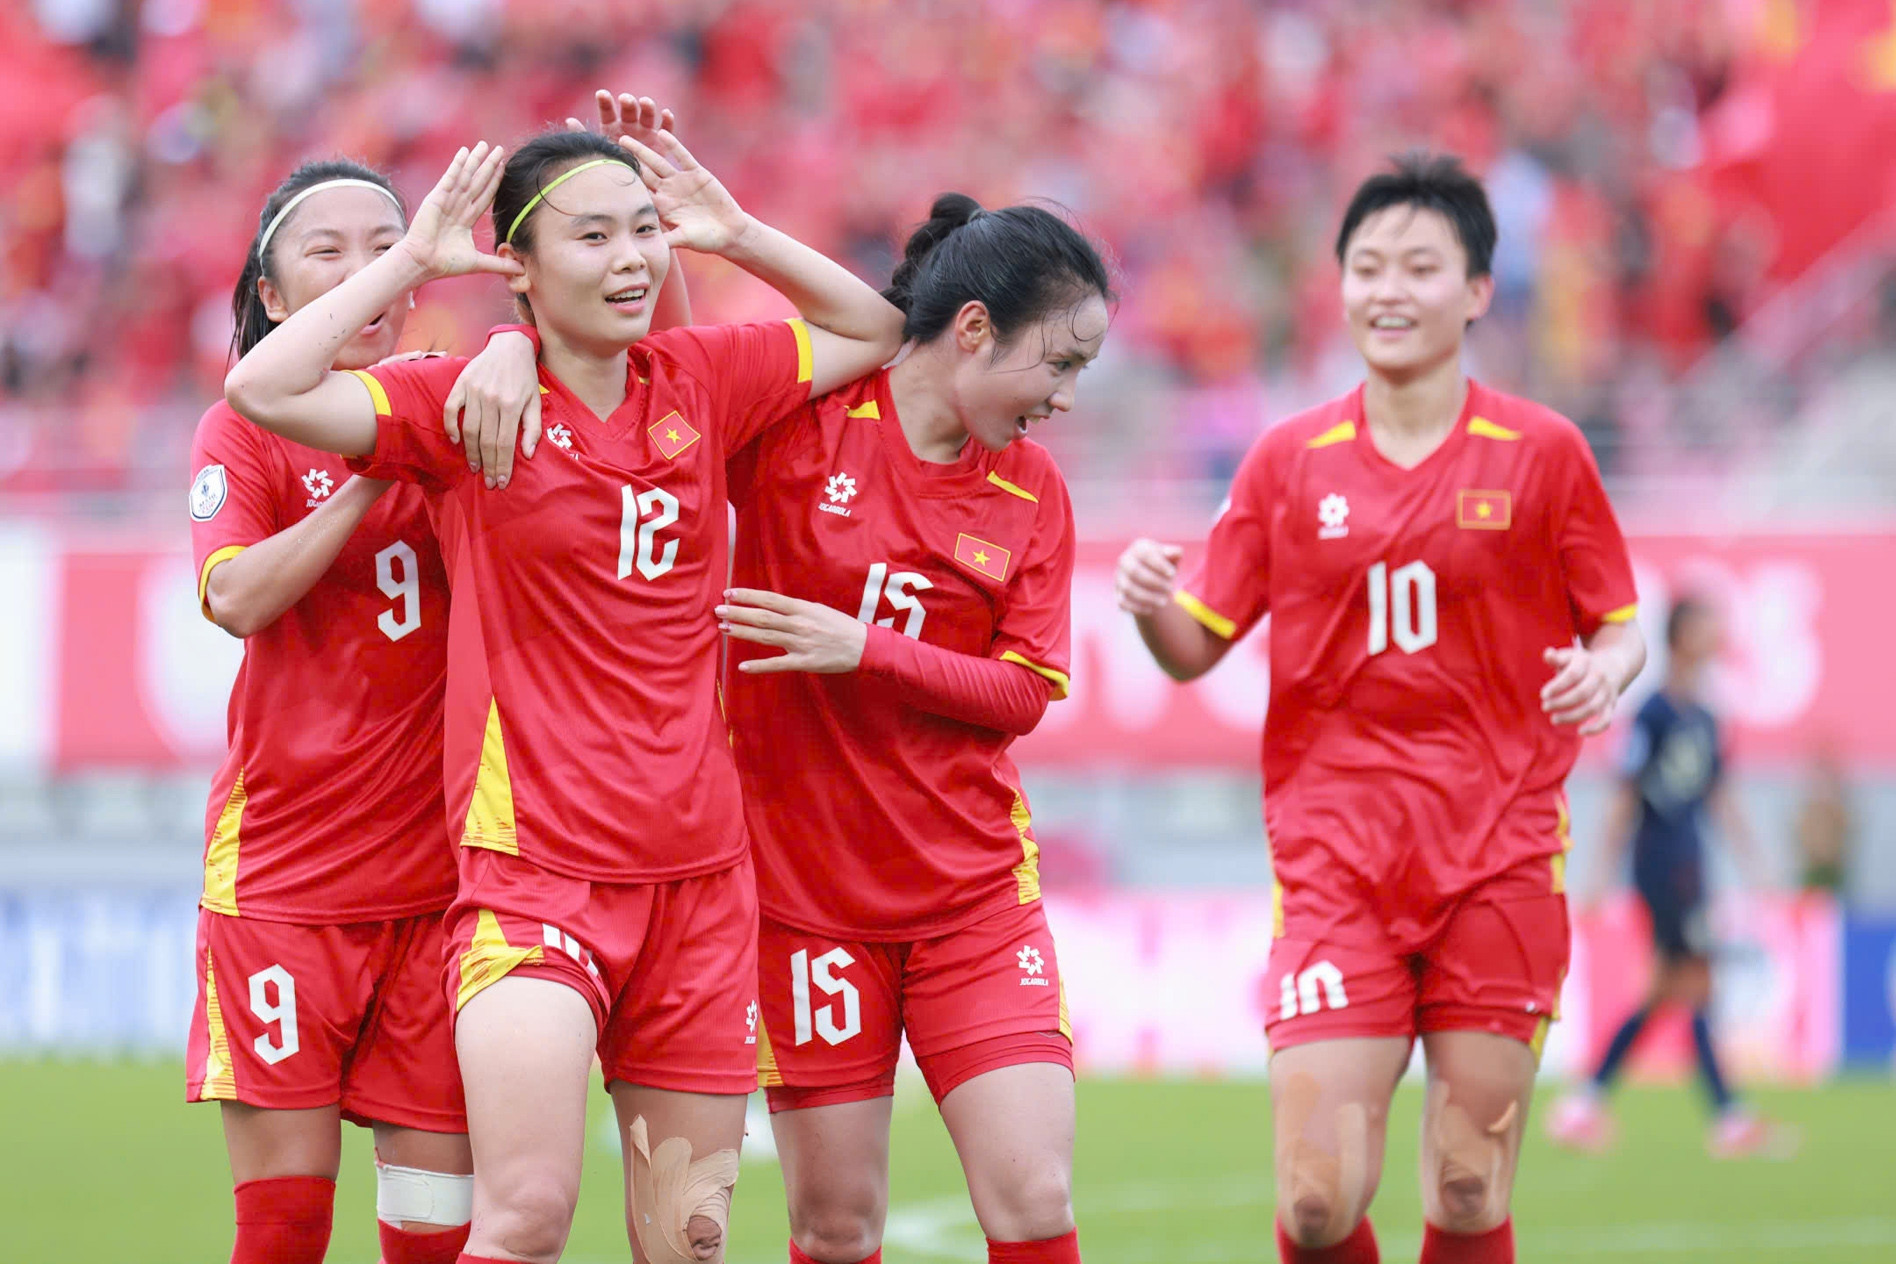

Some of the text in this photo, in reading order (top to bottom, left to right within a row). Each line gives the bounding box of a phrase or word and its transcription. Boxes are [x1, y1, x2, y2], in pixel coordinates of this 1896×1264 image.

[617, 484, 680, 581] 12
[375, 539, 421, 642] 9
[857, 562, 934, 641] 15
[1367, 560, 1438, 656] 10
[248, 964, 299, 1065] 9
[790, 946, 861, 1046] 15
